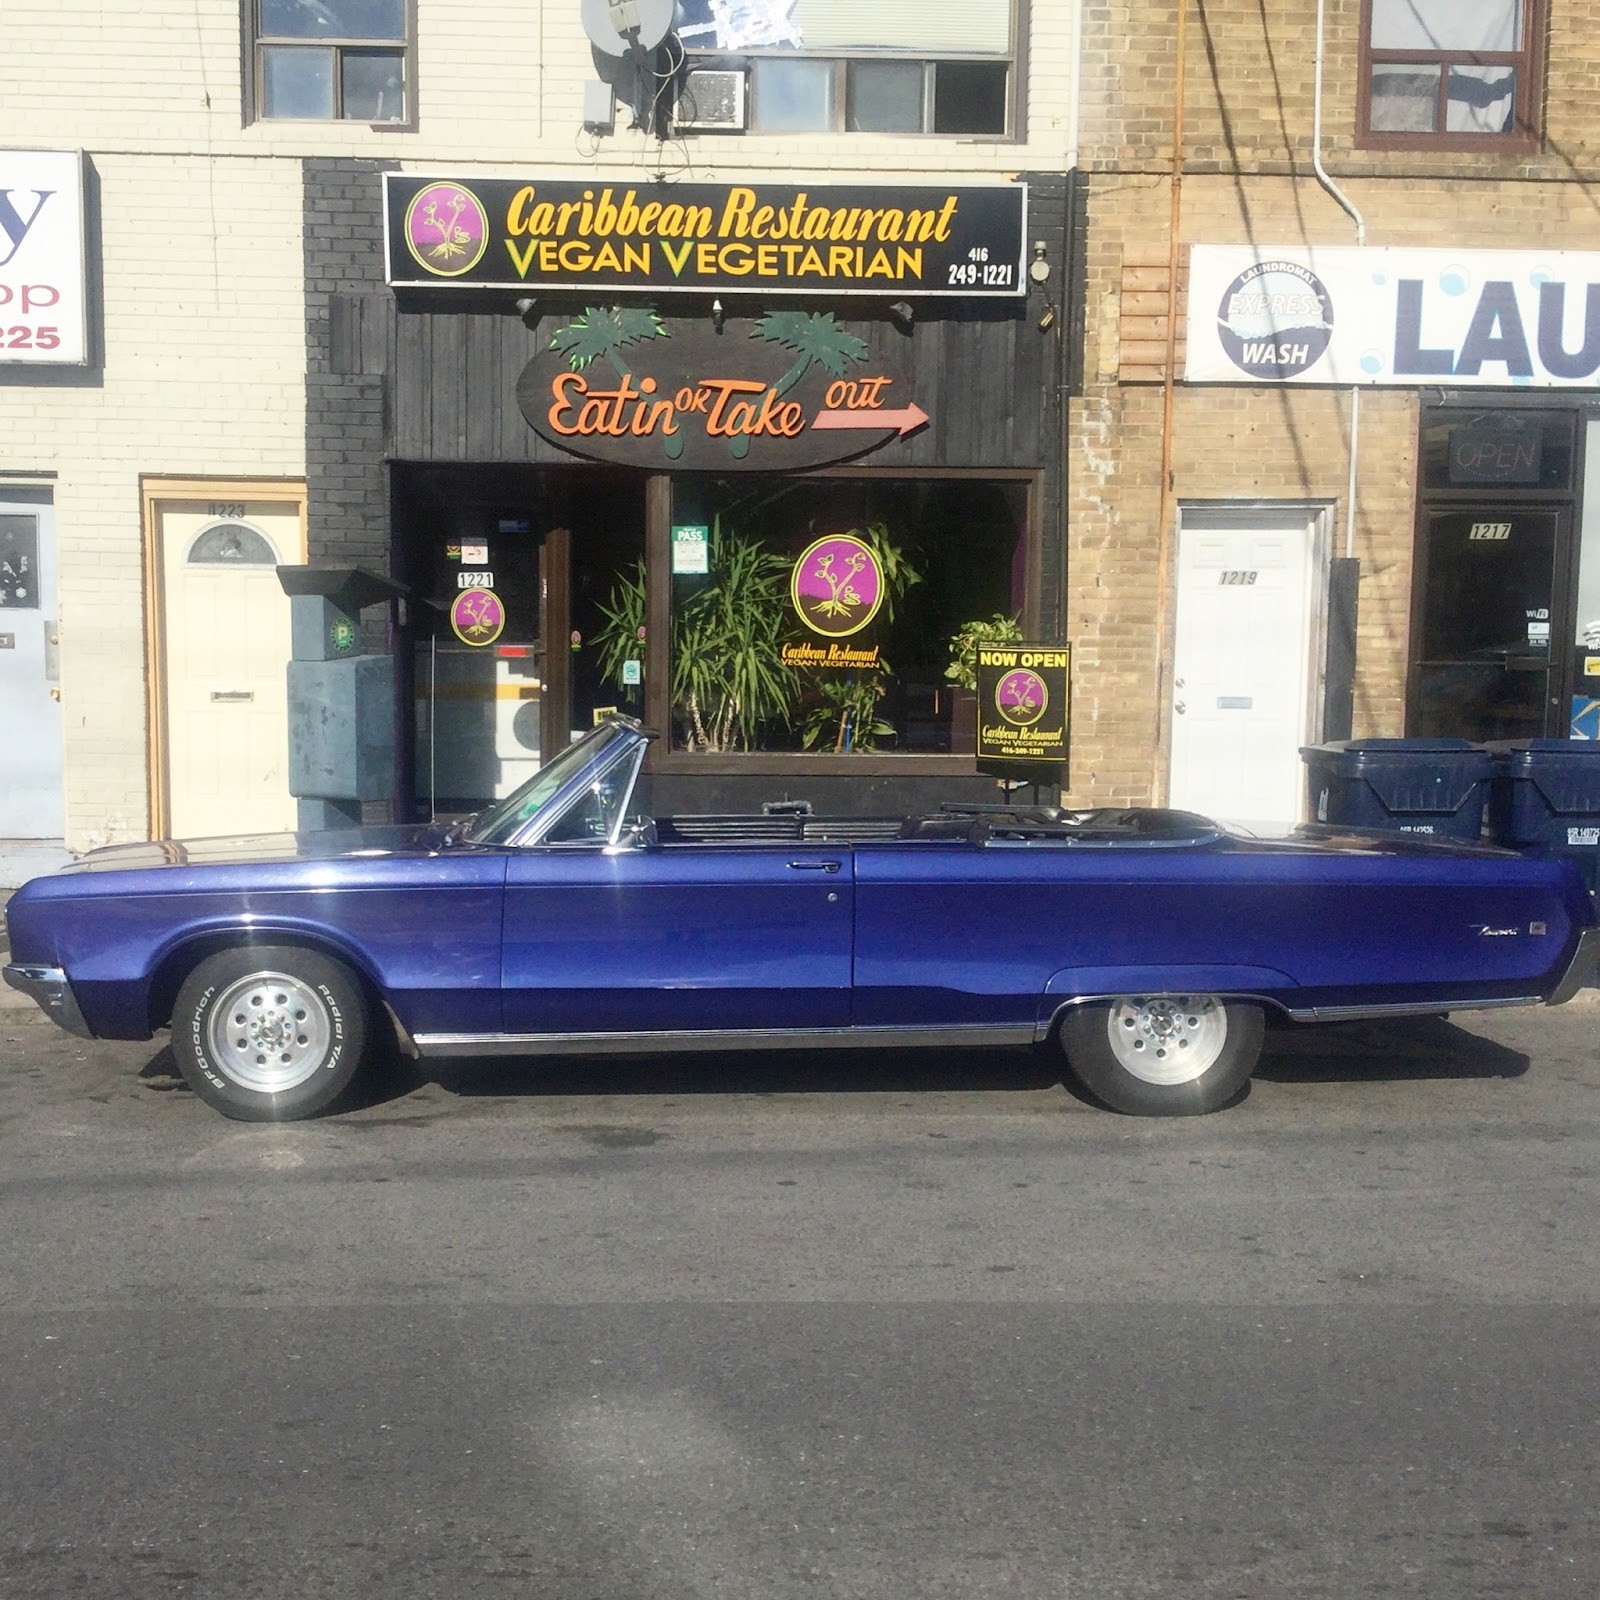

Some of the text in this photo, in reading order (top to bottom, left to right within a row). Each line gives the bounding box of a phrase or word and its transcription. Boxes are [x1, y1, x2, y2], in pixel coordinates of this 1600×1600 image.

[507, 185, 959, 242] Caribbean Restaurant
[504, 238, 923, 281] VEGAN VEGETARIAN
[968, 248, 989, 262] 416
[948, 263, 1012, 286] 249-1221
[1239, 262, 1318, 285] LAUNDROMAT
[1227, 292, 1326, 316] EXPRESS
[0, 325, 61, 350] 25
[1393, 279, 1600, 379] LAU
[1242, 343, 1309, 365] WASH
[698, 378, 806, 437] Take
[825, 376, 893, 410] out
[1456, 442, 1536, 469] OPEN
[677, 530, 703, 541] PASS
[1473, 524, 1510, 537] 1217
[460, 573, 492, 587] 1221
[1220, 572, 1257, 585] 1219
[781, 642, 879, 661] Caribbean Restaurant
[980, 652, 1066, 668] NOW OPEN
[781, 658, 880, 669] VEGAN VEGETARIAN
[982, 725, 1063, 740] Caribbean Restaurant
[983, 738, 1063, 747] VEGAN VEGETARIAN
[318, 984, 344, 1040] Radial
